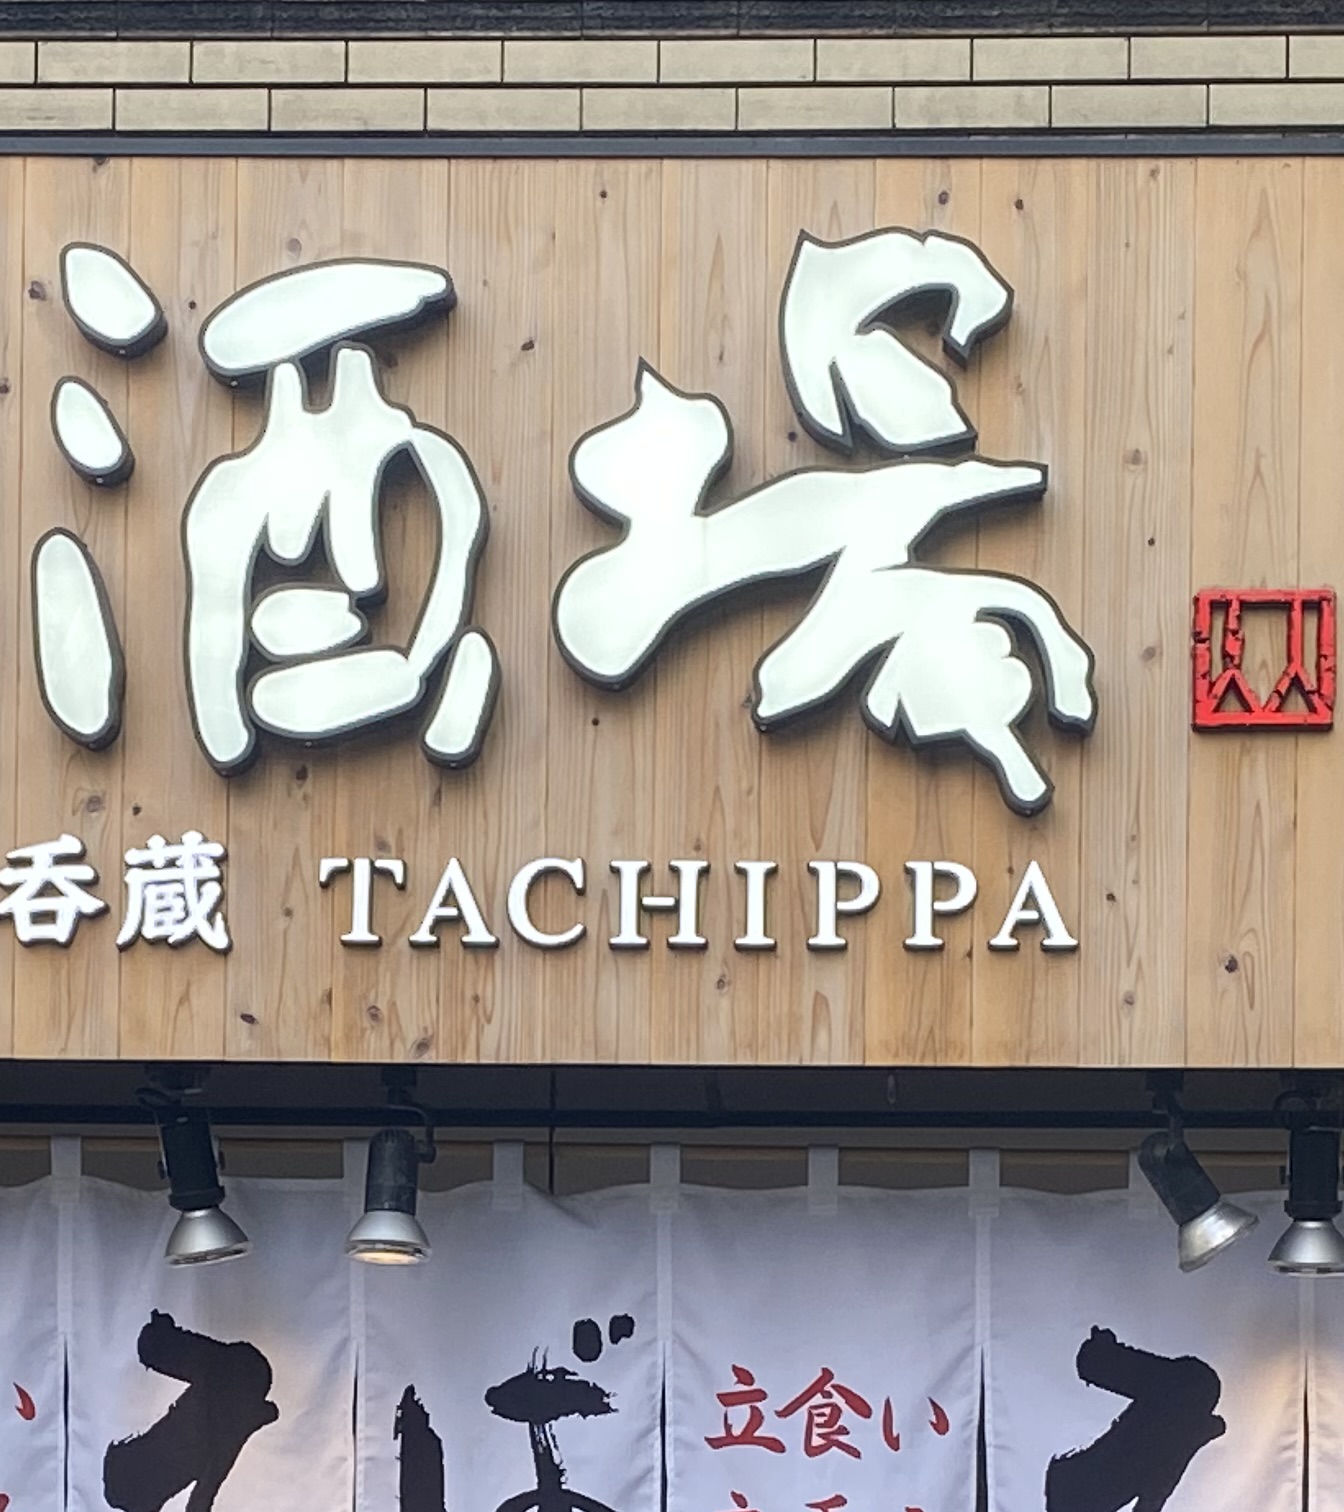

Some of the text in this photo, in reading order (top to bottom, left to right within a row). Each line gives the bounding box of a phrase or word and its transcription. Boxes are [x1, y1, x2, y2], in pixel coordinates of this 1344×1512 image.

[317, 856, 1080, 953] TACHIPPA
[704, 1363, 950, 1460] 立食い
